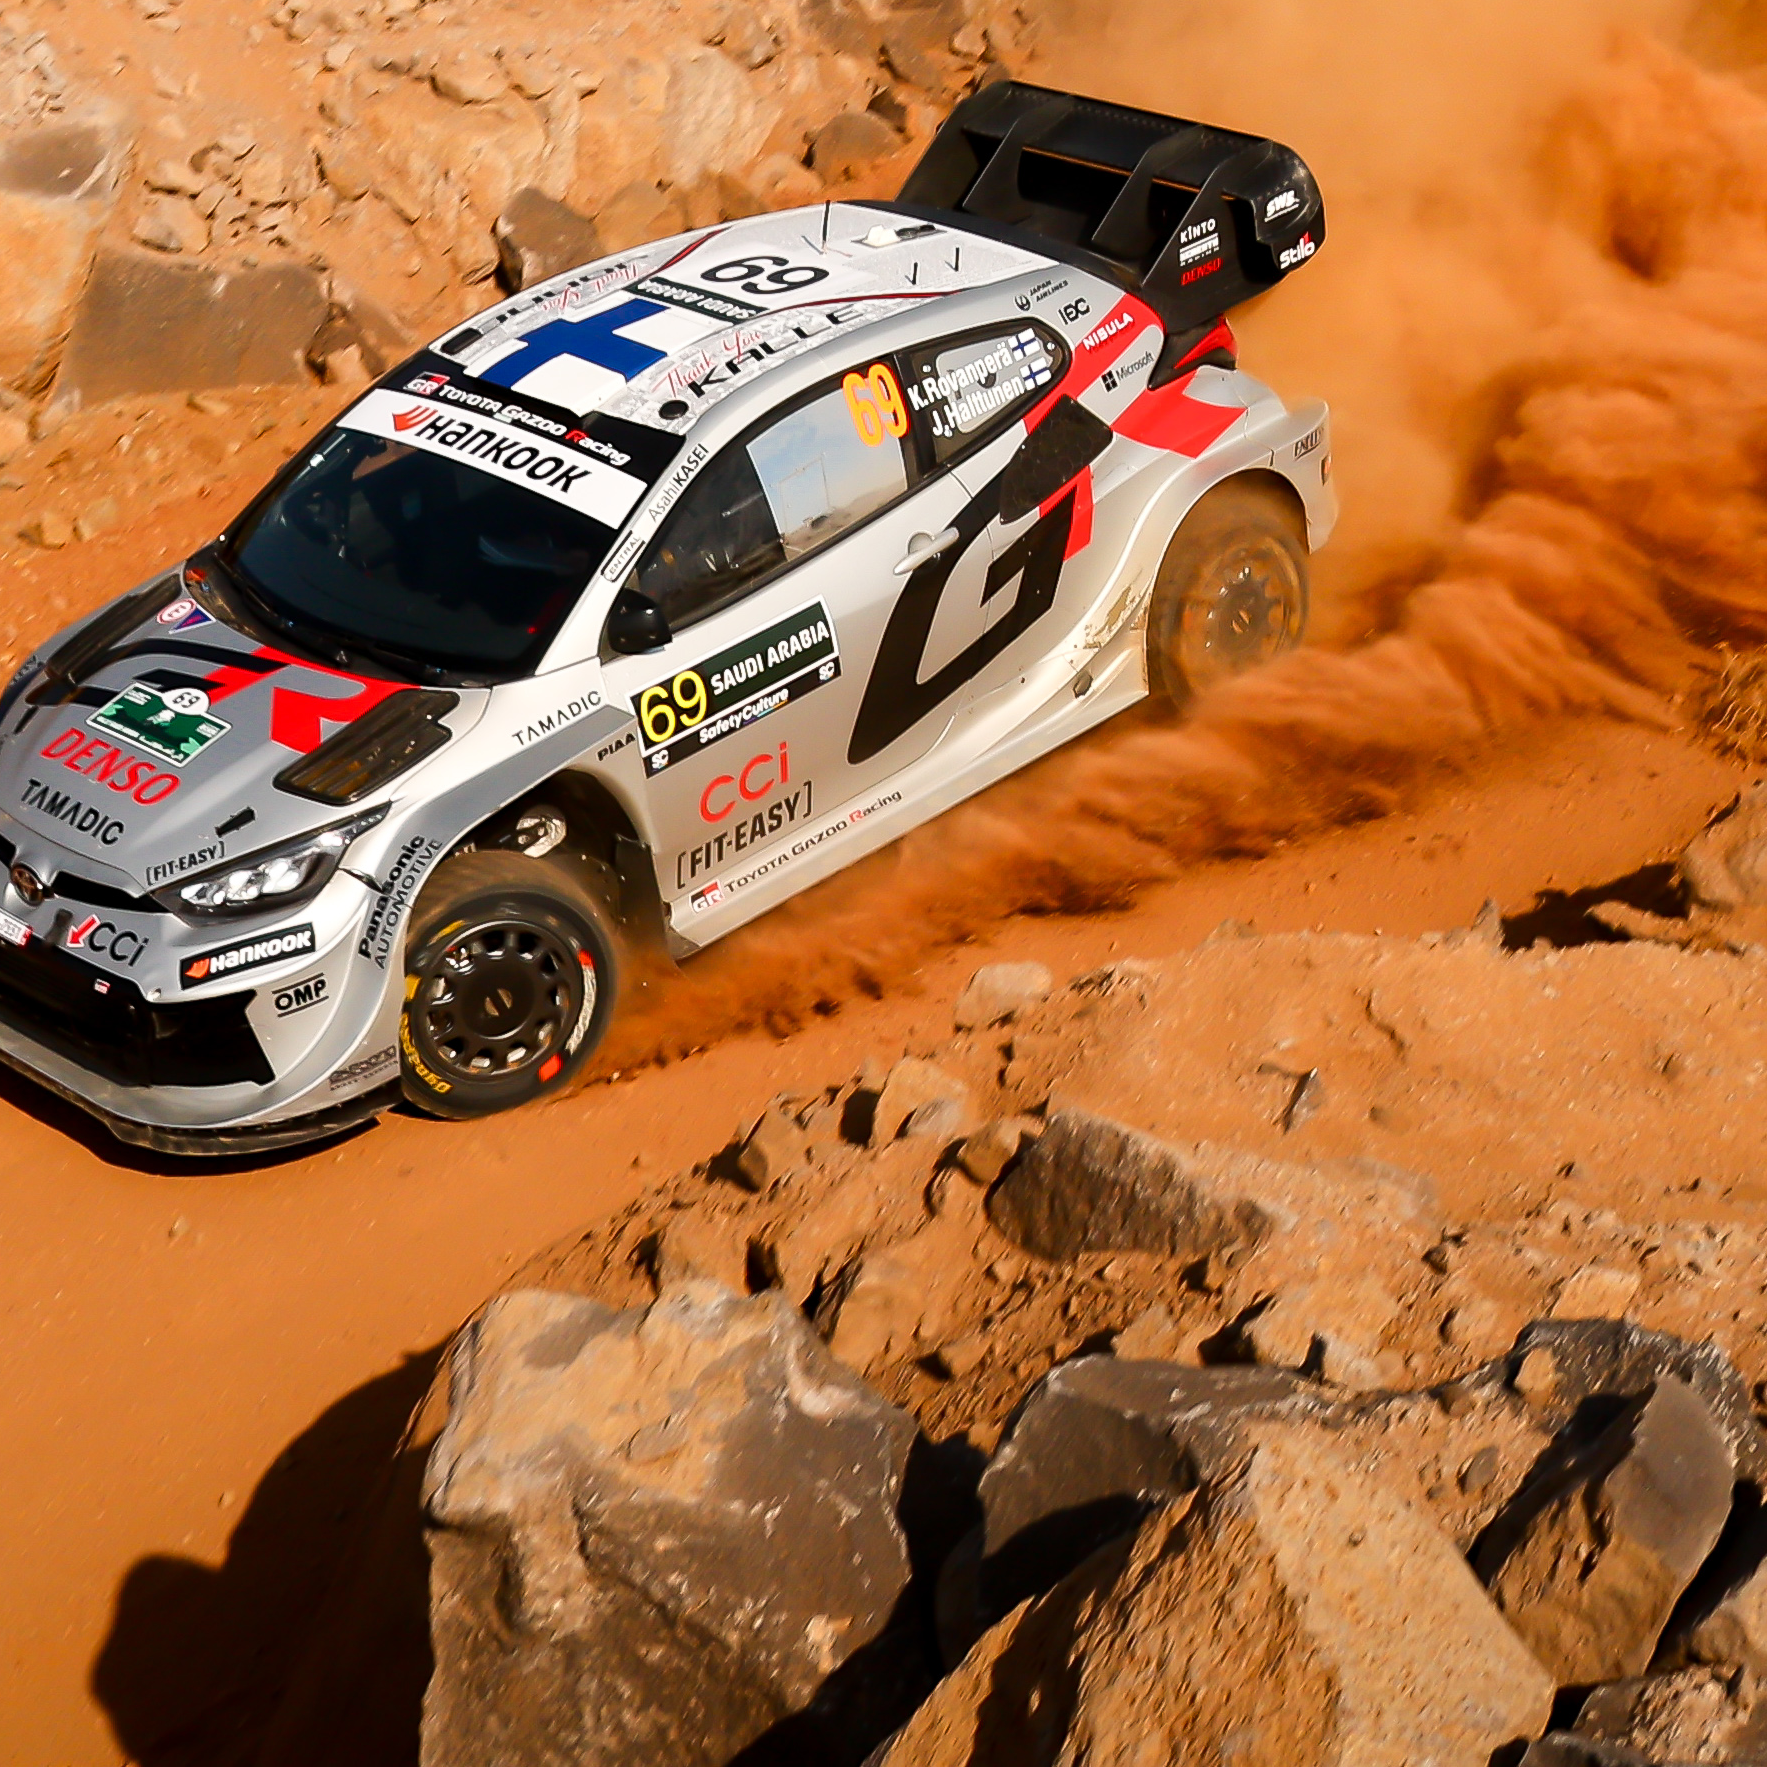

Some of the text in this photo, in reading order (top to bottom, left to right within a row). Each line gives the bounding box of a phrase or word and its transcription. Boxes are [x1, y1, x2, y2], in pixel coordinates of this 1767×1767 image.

[701, 255, 830, 294] 69
[1279, 231, 1315, 269] Stilo
[1030, 280, 1052, 297] JAPAN
[1036, 280, 1069, 302] AIRLINES
[651, 331, 762, 398] Thank You
[688, 305, 864, 398] KALLE
[907, 341, 1013, 412] K.Rovanperä
[439, 384, 503, 413] TOYOTA
[502, 404, 567, 437] GAZOO
[565, 429, 631, 467] Racing
[842, 362, 909, 448] 69
[639, 620, 830, 744] 69 SAUDI ARABIA
[512, 690, 602, 747] TAMADIC
[597, 732, 636, 761] PIAA
[40, 727, 181, 806] DENSO
[19, 778, 124, 846] TAMADIC
[724, 853, 790, 893] TOYOTA
[791, 820, 848, 856] GAZOO
[848, 790, 903, 824] Racing
[358, 835, 426, 960] Panasonic
[374, 839, 444, 970] AUTOMOTIVE
[274, 978, 327, 1012] OMP
